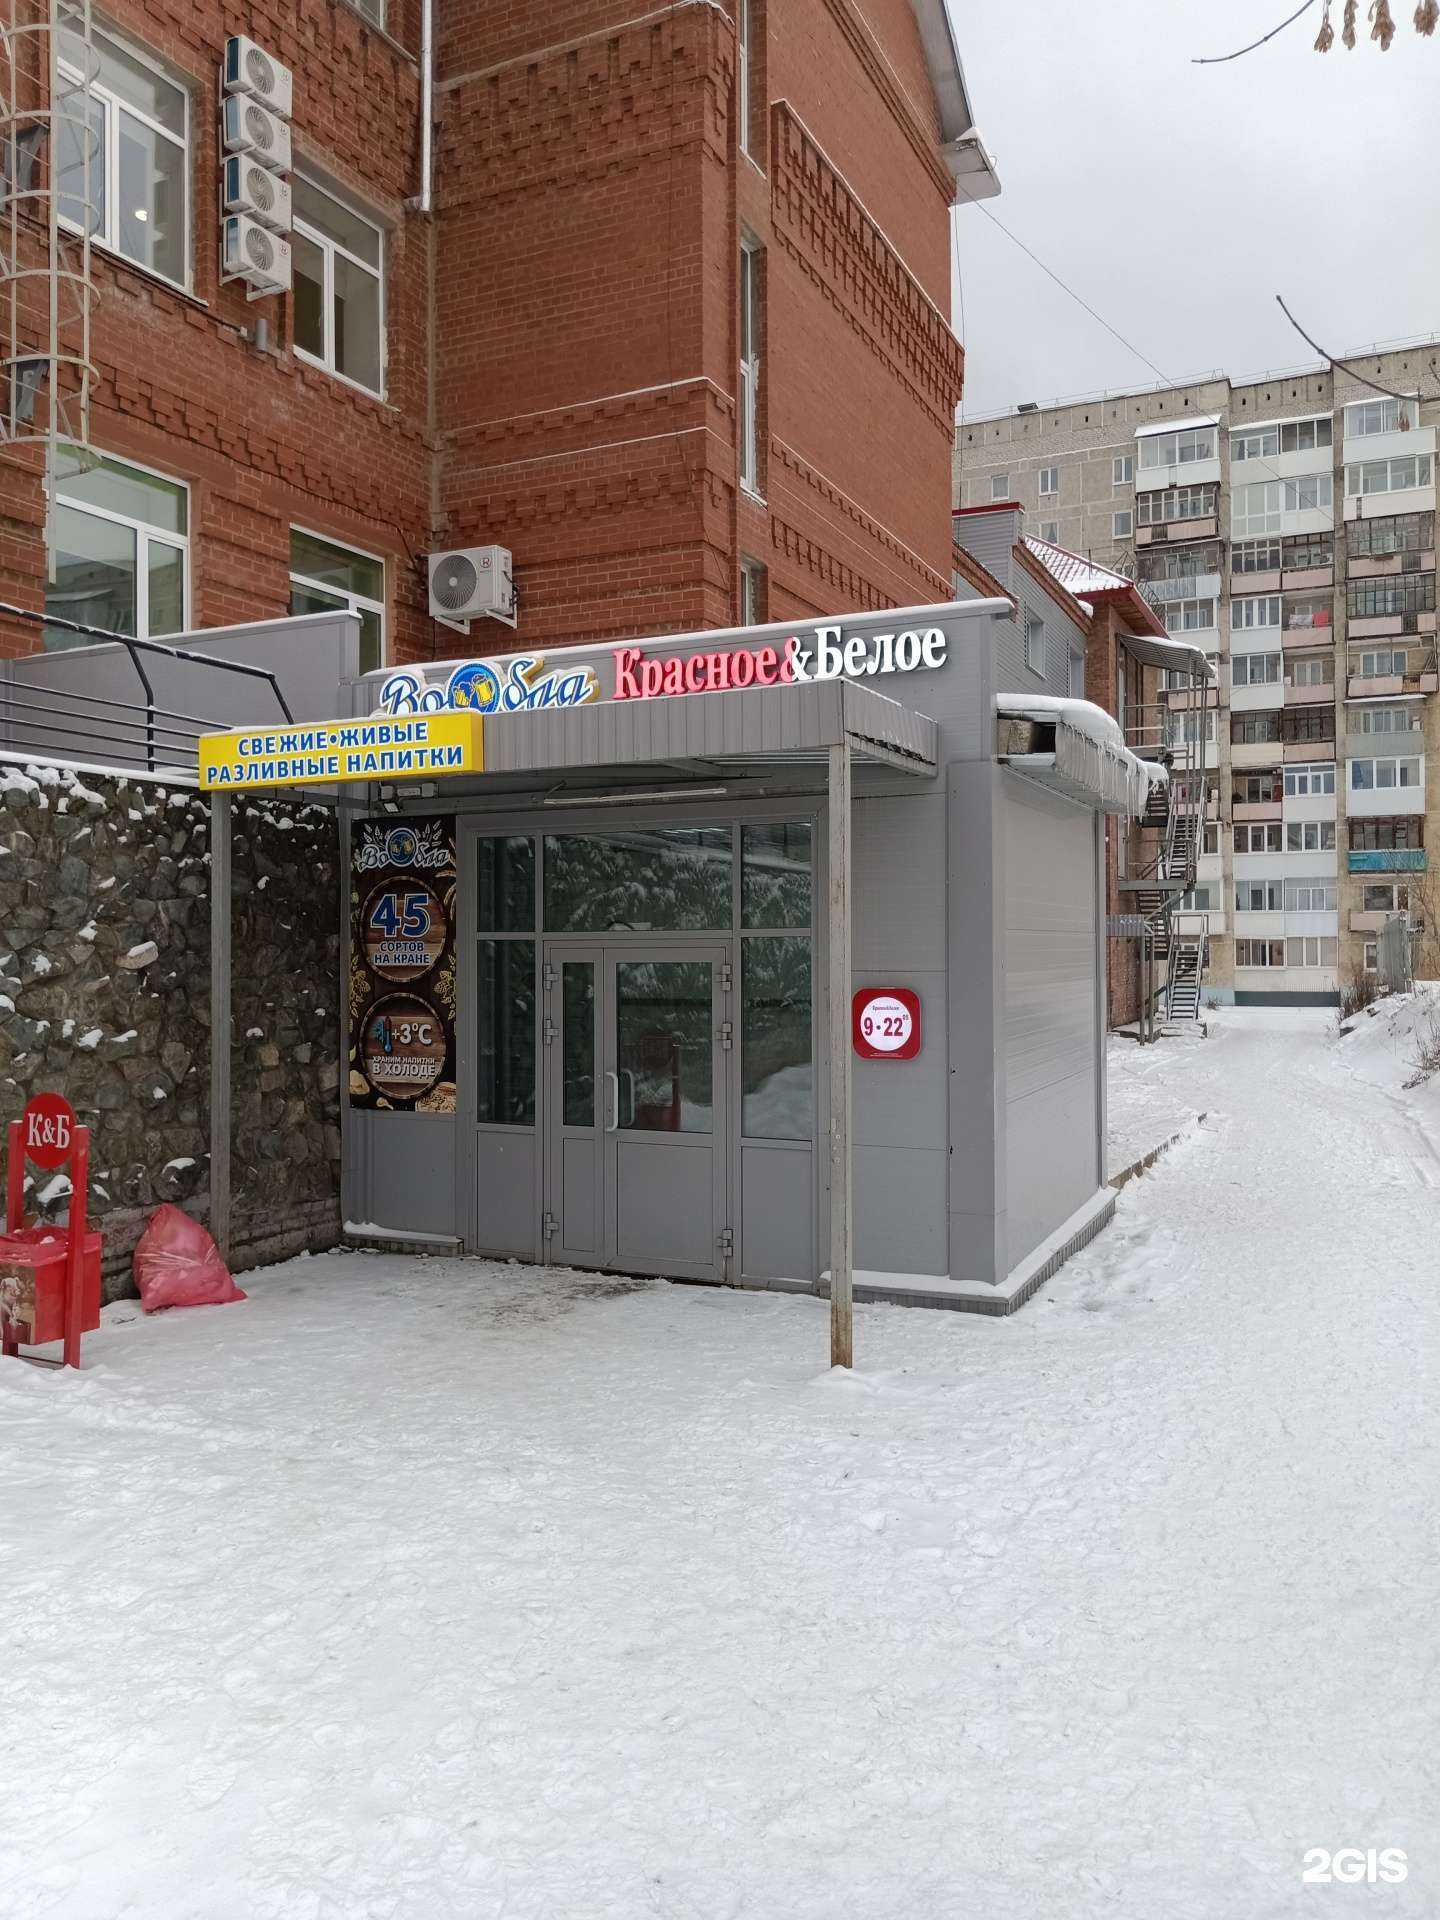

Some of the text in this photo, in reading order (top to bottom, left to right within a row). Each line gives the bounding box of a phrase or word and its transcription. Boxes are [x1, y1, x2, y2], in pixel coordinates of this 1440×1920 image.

[206, 744, 464, 784] РАЗЛИВНЫЕ НАПИТКИ
[370, 894, 431, 938] 45
[374, 954, 431, 965] НА КРАНЕ
[379, 942, 425, 953] СОРТОВ
[373, 1064, 436, 1078] В ХОЛОДЕ
[26, 1113, 70, 1149] К&Б
